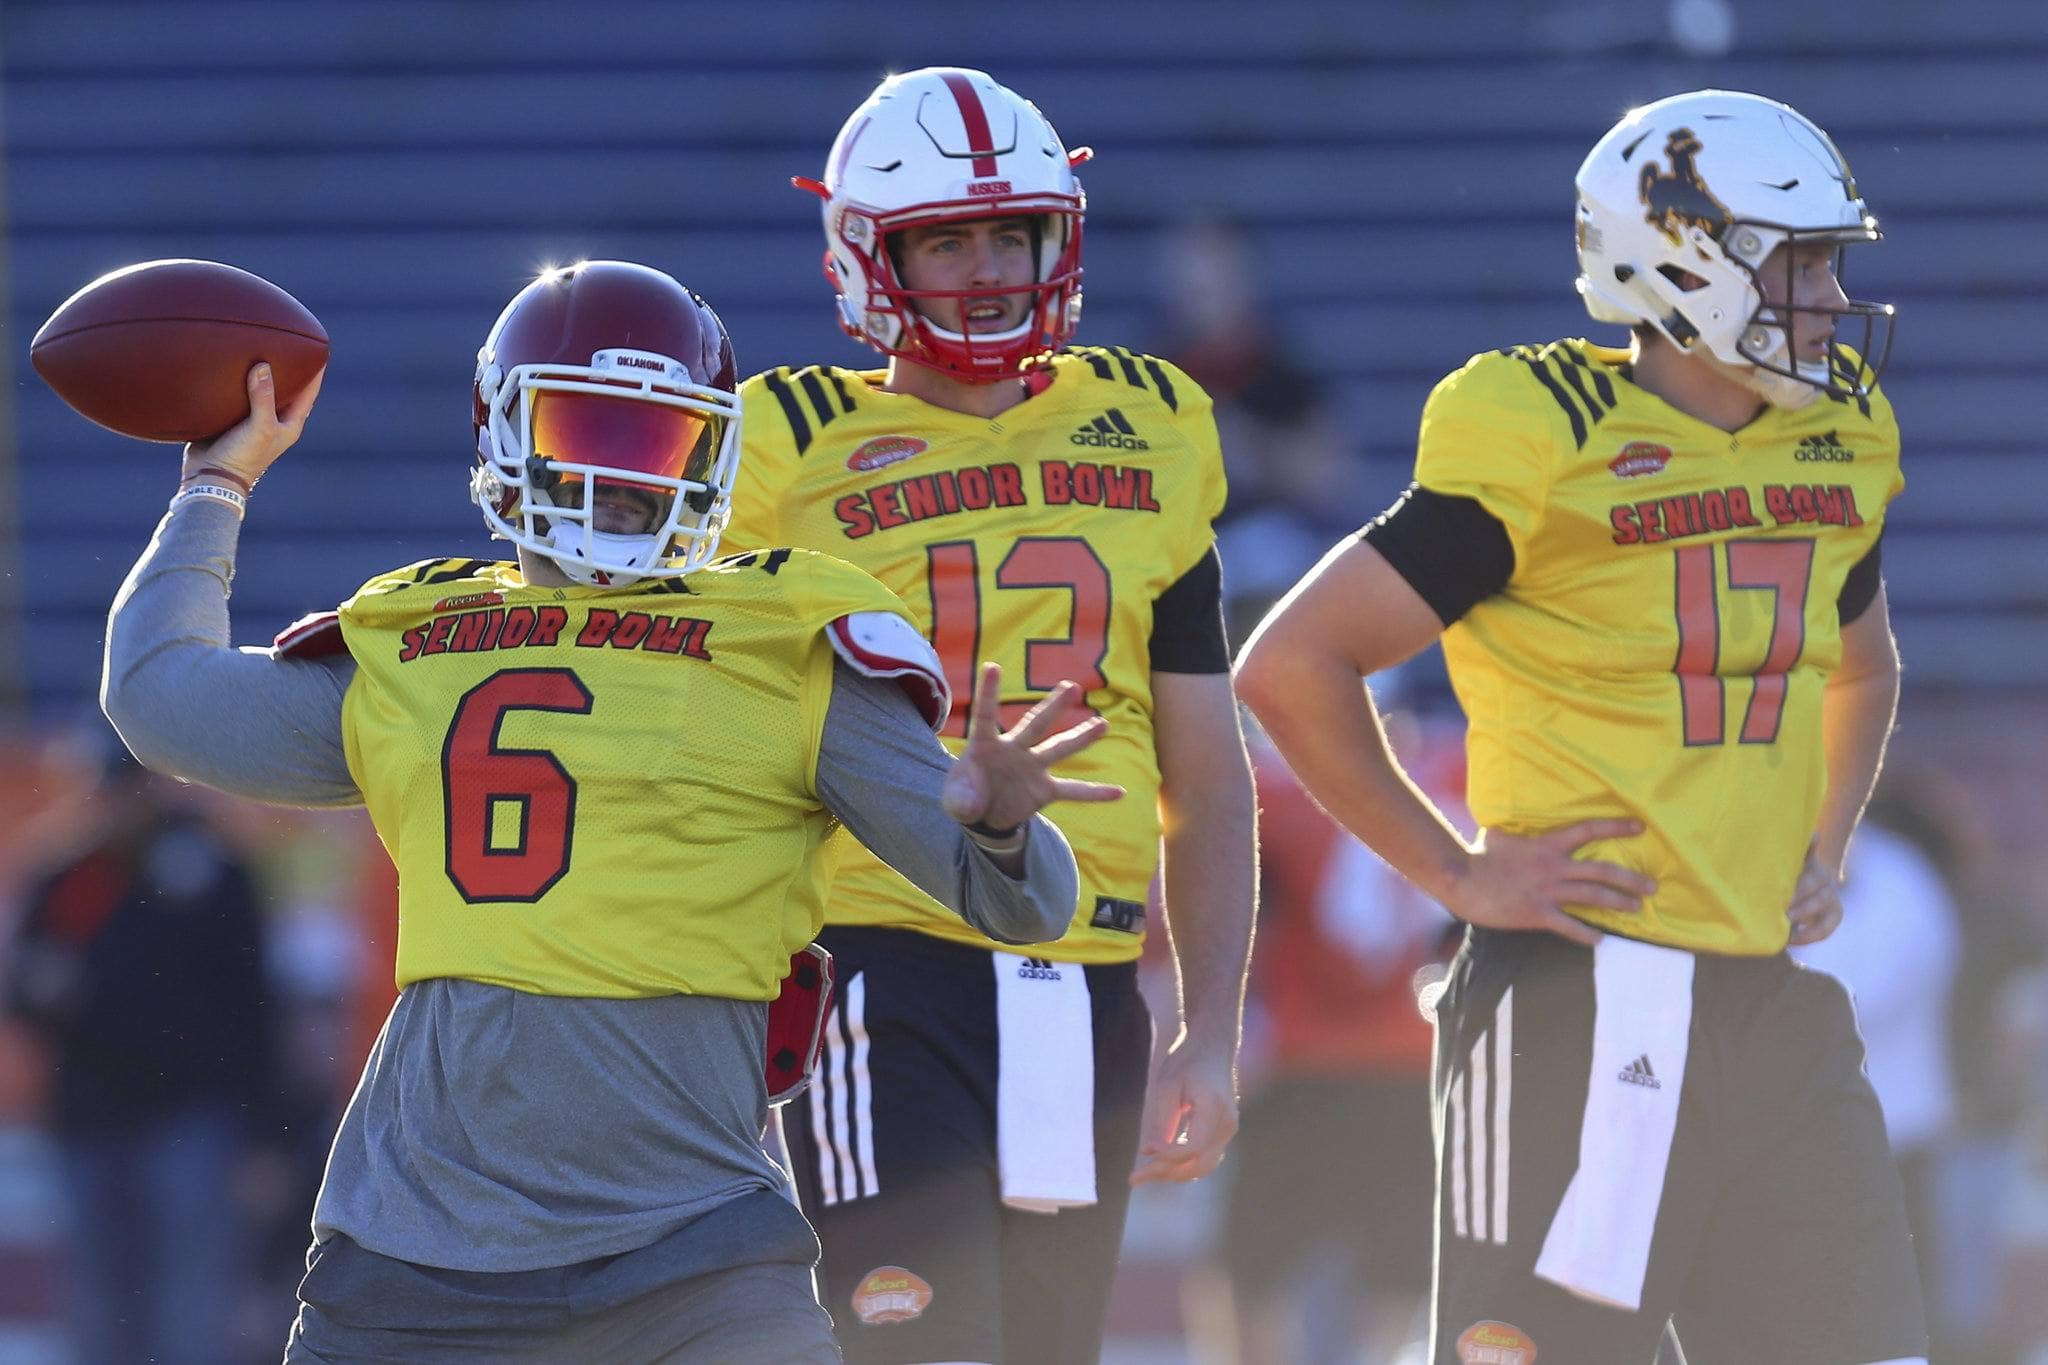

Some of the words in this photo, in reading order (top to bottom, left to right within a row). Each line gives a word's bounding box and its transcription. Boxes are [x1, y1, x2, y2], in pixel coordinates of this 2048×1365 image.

[616, 356, 666, 373] OKLAHOMA
[1070, 431, 1149, 450] adidas
[1795, 449, 1854, 463] adidas
[834, 462, 1027, 540] SENIOR
[1039, 460, 1161, 513] BOWL
[1609, 485, 1763, 546] SENIOR
[1763, 483, 1864, 527] BOWL
[399, 606, 568, 663] SENIOR
[575, 607, 714, 662] BOWL
[926, 535, 1112, 739] 13
[1671, 537, 1816, 747] 17
[440, 667, 595, 905] 6
[1018, 968, 1062, 981] adidas
[1617, 1071, 1662, 1090] adidas
